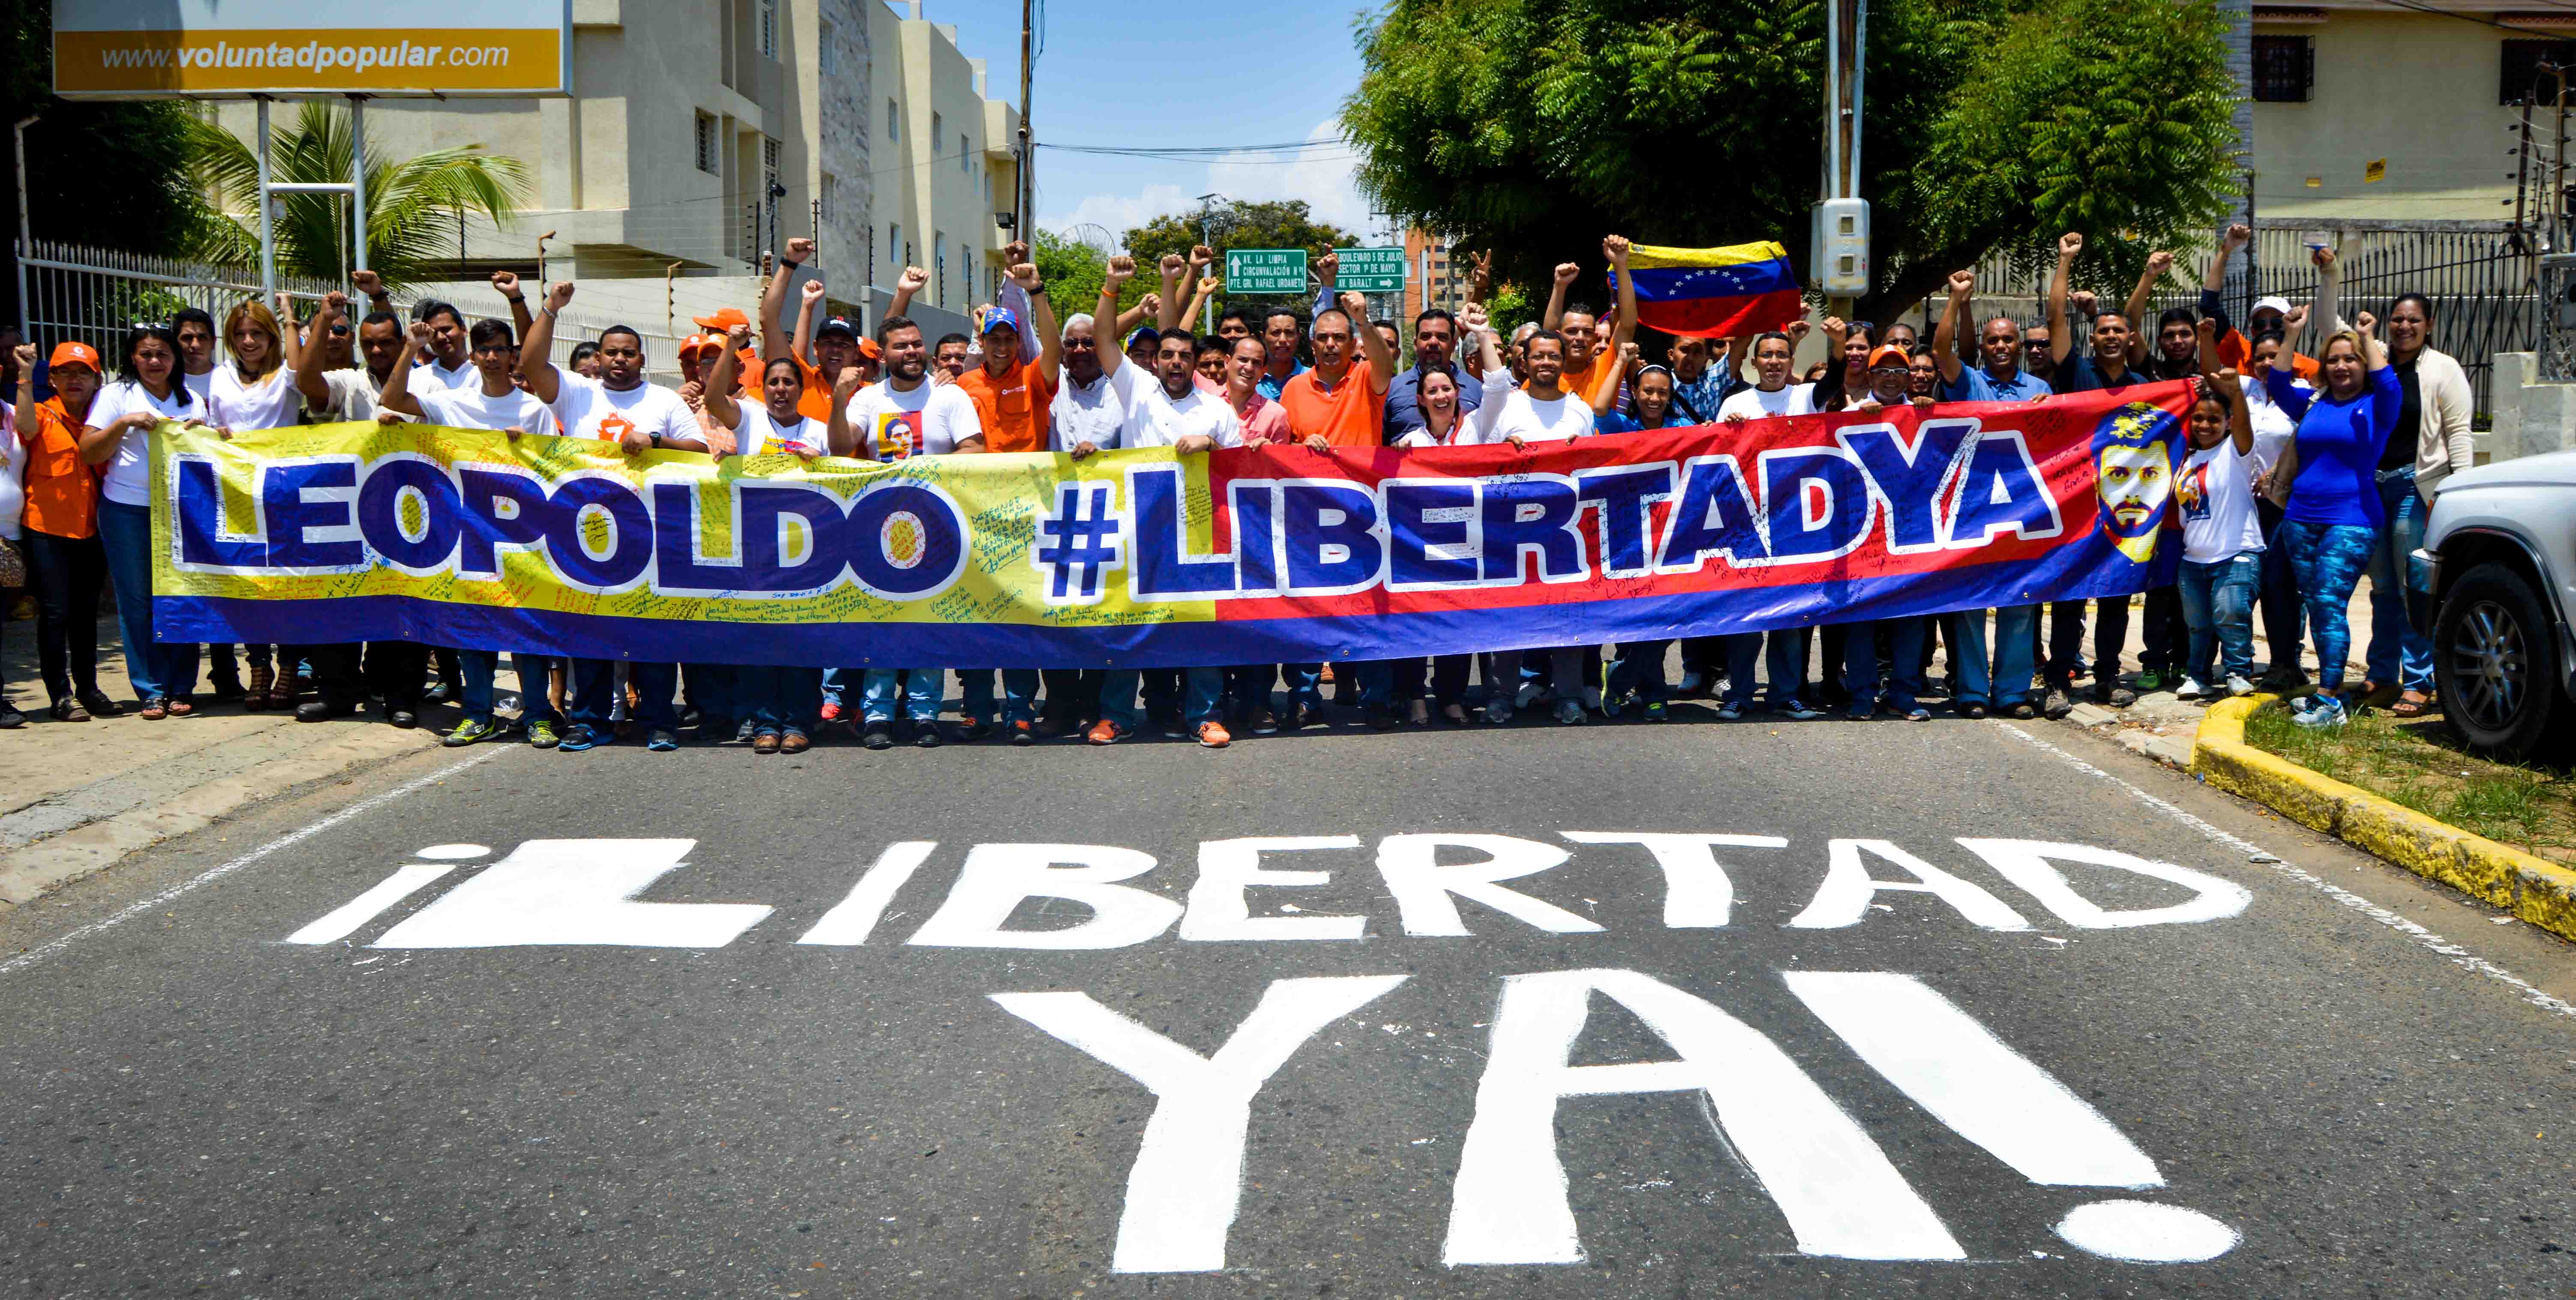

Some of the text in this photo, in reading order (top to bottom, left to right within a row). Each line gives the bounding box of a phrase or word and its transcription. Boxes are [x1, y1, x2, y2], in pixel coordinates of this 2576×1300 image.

[102, 40, 509, 73] www.voluntadpopular.com
[1243, 254, 1287, 264] AV. LA LIMPIA
[1338, 251, 1402, 262] BOULEVARD 5 DE JULIO
[1243, 265, 1290, 276] CIRCUNVALACIÓN
[1338, 264, 1361, 274] SECTOR
[1370, 263, 1378, 273] DE
[1380, 263, 1396, 273] MAYO
[1230, 278, 1242, 288] PTE.
[1255, 278, 1275, 288] RAFAEL
[1277, 278, 1304, 288] URDANETA
[1338, 278, 1372, 288] AV. BARALT
[171, 453, 970, 602] LEOPOLDO
[1031, 417, 2062, 605] #LIBERTADYA
[991, 967, 2240, 1273] YA!
